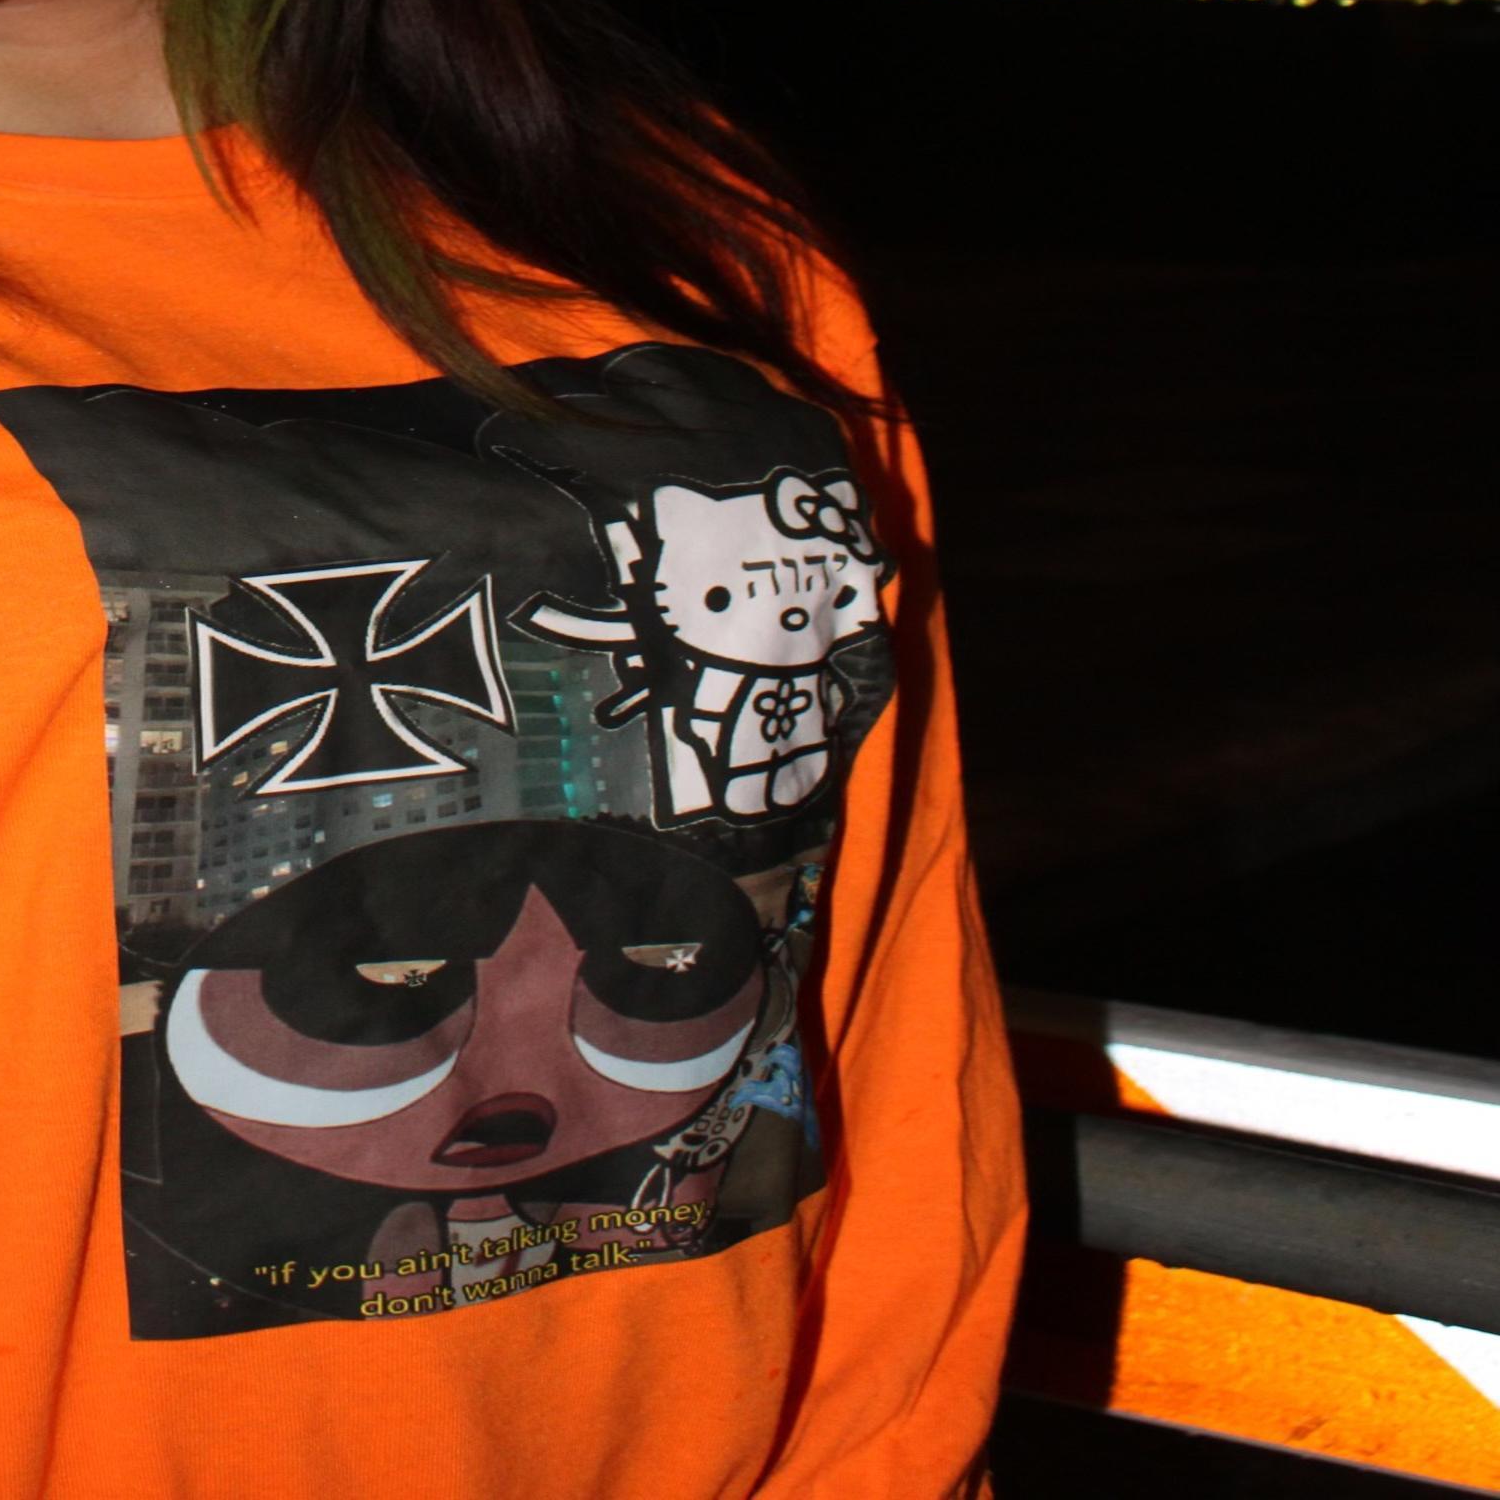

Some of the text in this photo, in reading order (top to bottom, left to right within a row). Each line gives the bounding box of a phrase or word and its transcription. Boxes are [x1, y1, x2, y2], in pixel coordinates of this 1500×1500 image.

[741, 552, 849, 599] יהוה
[307, 1261, 382, 1289] you
[396, 1242, 473, 1277] ain't
[481, 1215, 578, 1259] talking
[359, 1285, 455, 1318] don't
[463, 1260, 559, 1302] wanna
